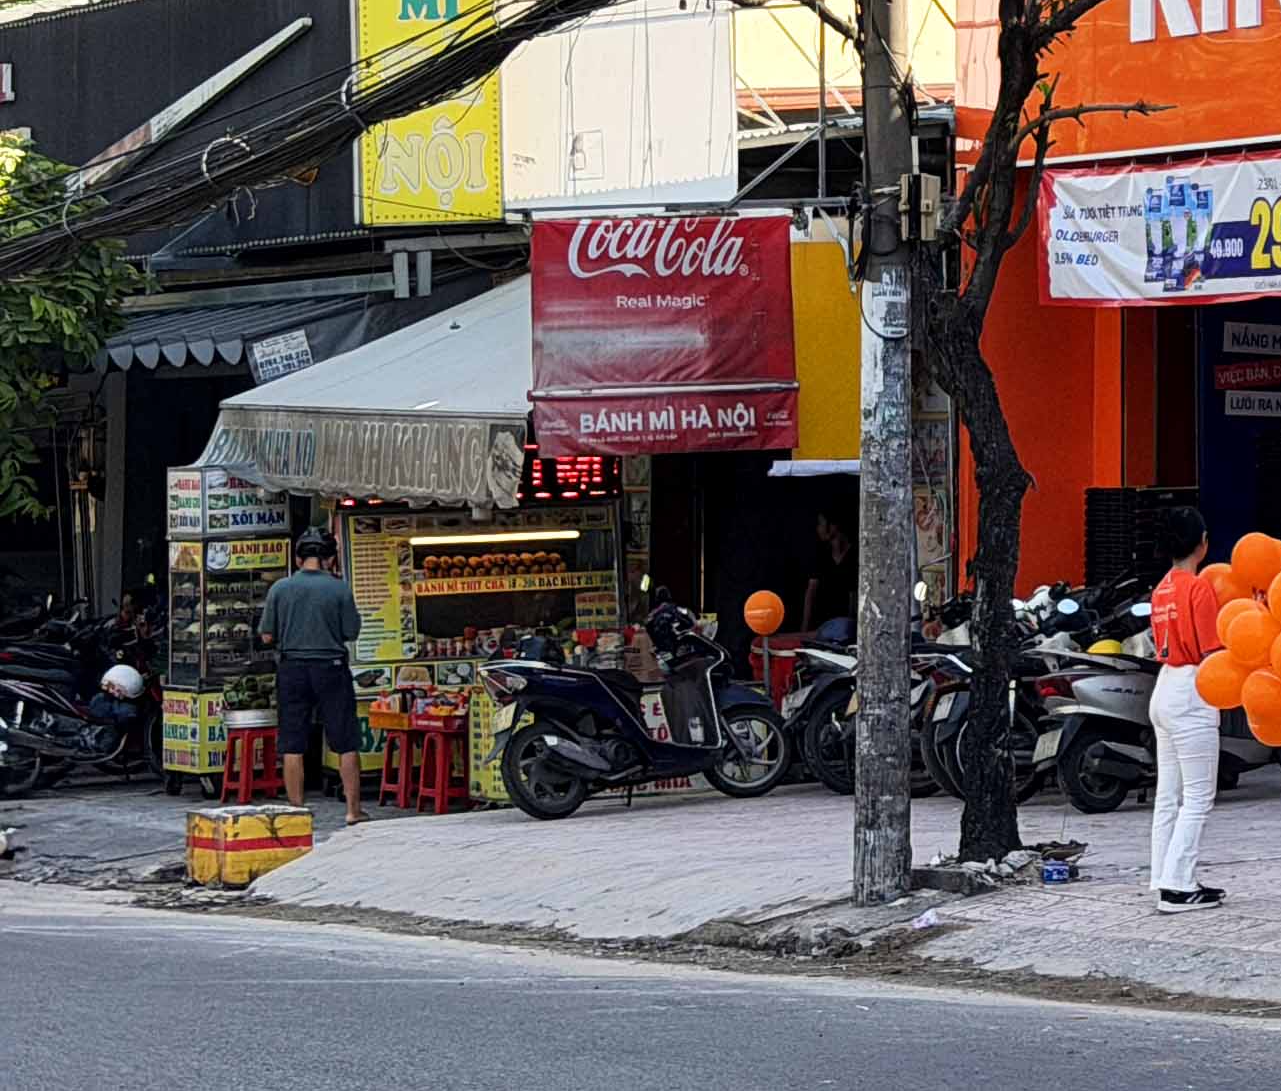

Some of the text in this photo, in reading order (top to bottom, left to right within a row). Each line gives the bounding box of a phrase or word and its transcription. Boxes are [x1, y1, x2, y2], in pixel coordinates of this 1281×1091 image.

[379, 116, 487, 207] NỘI
[616, 294, 705, 309] Real Magic
[579, 409, 643, 434] BÁNH
[650, 407, 676, 431] MÌ
[682, 404, 713, 430] HÀ
[718, 402, 756, 432] NỘI
